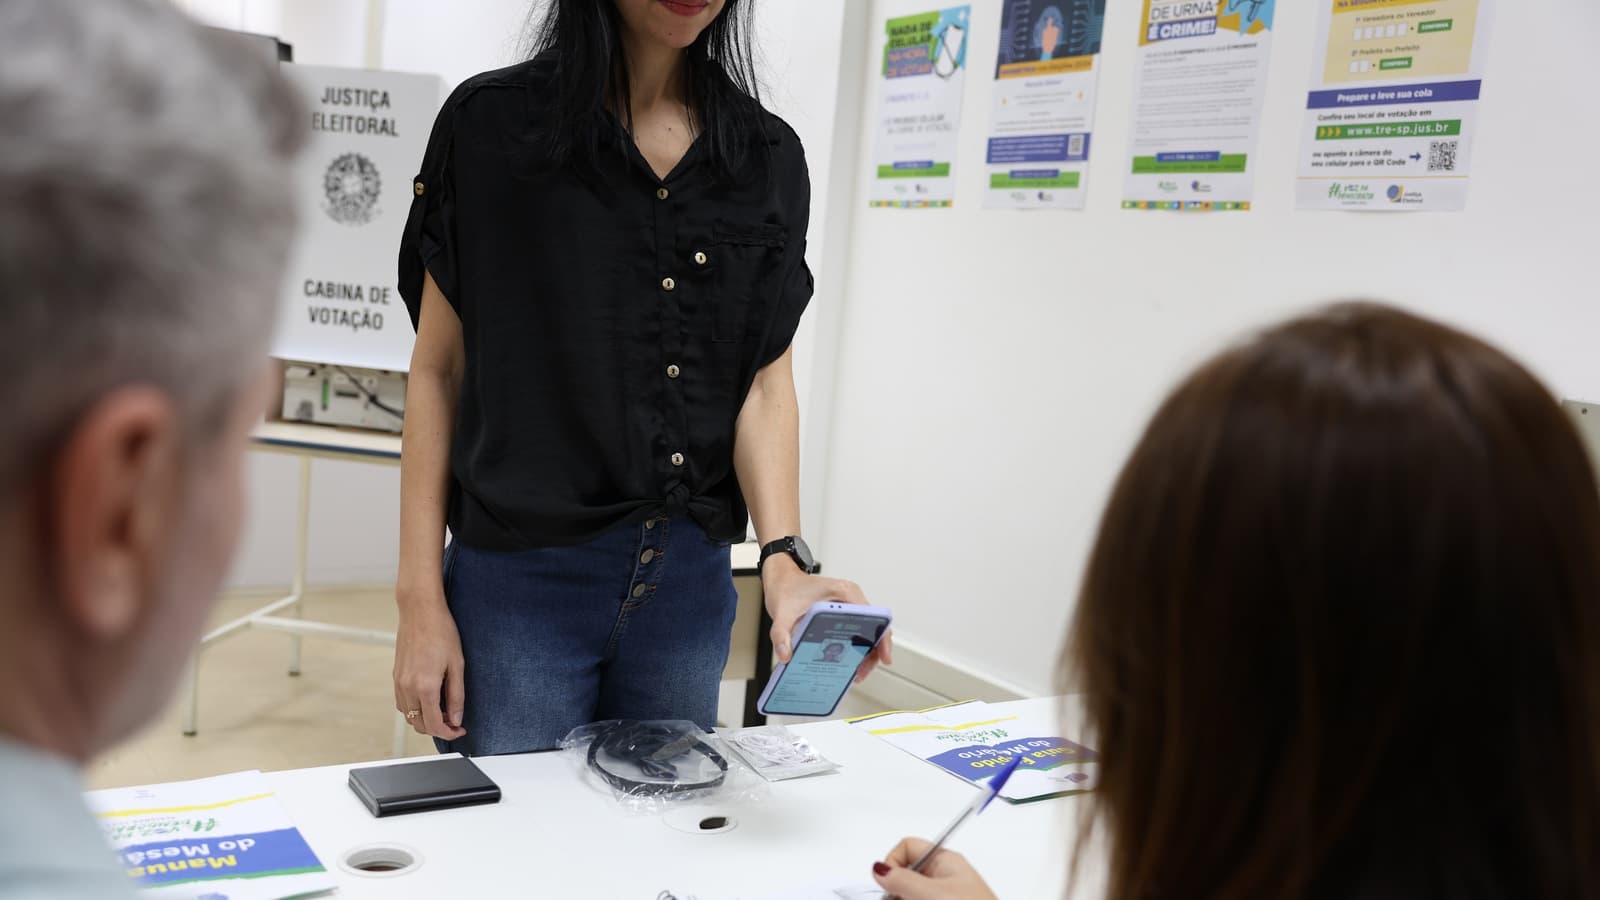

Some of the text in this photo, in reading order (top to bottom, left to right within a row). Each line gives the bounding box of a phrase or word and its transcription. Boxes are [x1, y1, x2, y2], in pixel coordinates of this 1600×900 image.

[1151, 3, 1214, 20] DE URNA
[1148, 19, 1216, 40] É CRIME!
[321, 87, 391, 112] JUSTIÇA
[1337, 93, 1369, 103] Prepare
[1377, 91, 1395, 100] leve
[1396, 91, 1412, 99] sua
[1414, 89, 1433, 98] cola
[1358, 110, 1374, 120] local
[1376, 110, 1385, 118] de
[1387, 109, 1417, 119] votação
[312, 112, 399, 138] ELEITORAL
[1347, 123, 1448, 137] www.tre-sp.jus.br
[1323, 151, 1347, 159] aponte
[1355, 149, 1381, 157] câmera
[1382, 148, 1392, 156] do
[1325, 159, 1347, 167] celular
[1349, 160, 1364, 168] para
[1373, 159, 1385, 167] QR
[1386, 158, 1406, 166] Code
[303, 279, 391, 305] CABINA DE
[308, 306, 384, 333] VOTAÇÃO
[1029, 740, 1050, 748] do
[970, 756, 1035, 769] Rpido
[122, 838, 255, 865] do Mesá
[128, 854, 237, 878] Manua
